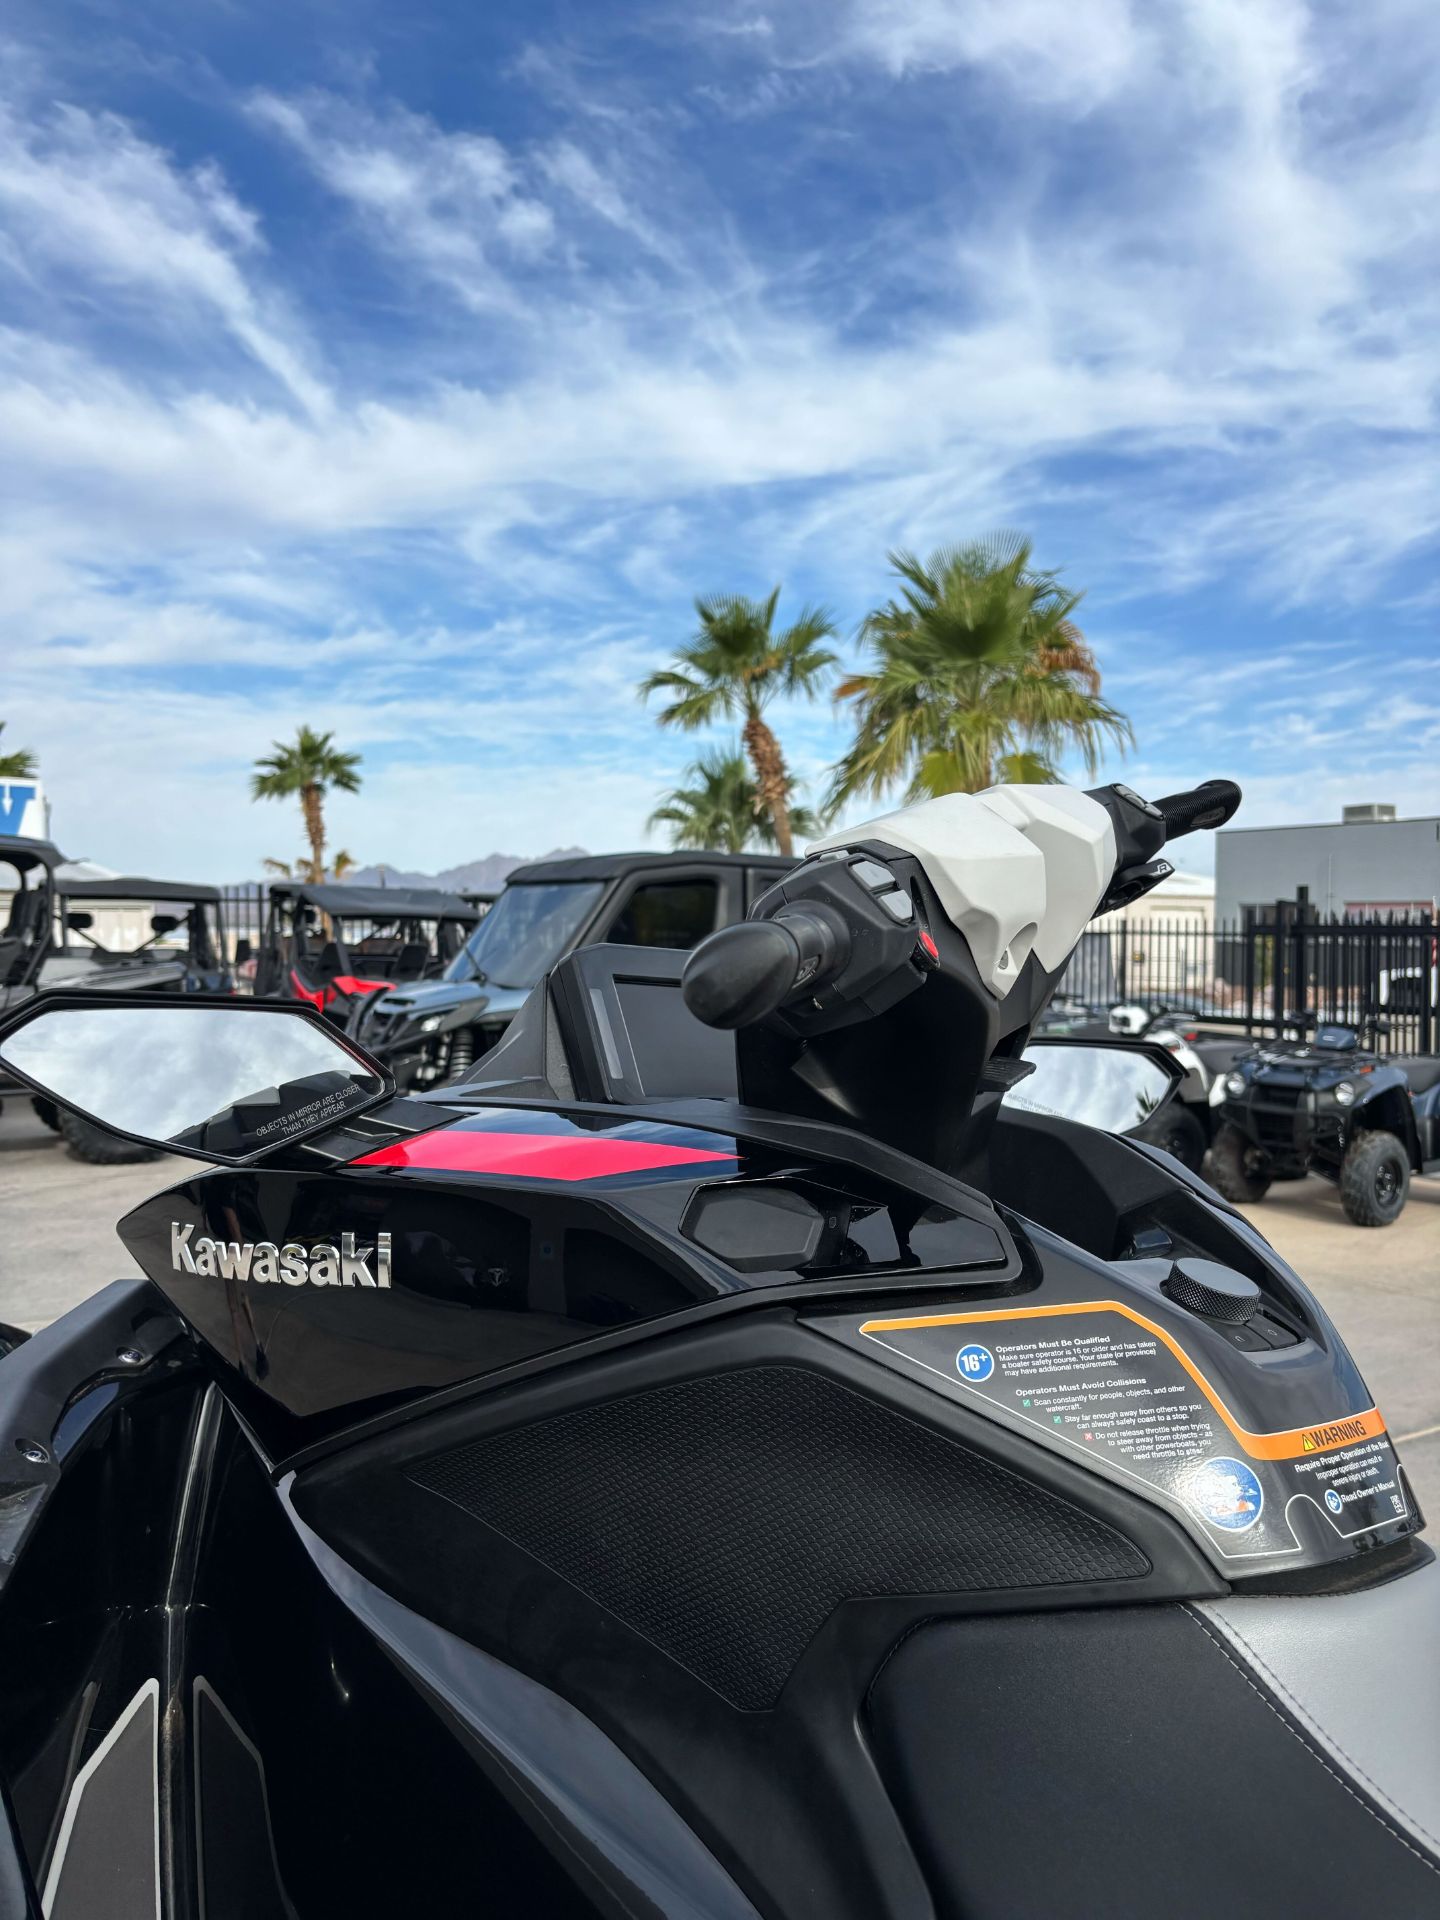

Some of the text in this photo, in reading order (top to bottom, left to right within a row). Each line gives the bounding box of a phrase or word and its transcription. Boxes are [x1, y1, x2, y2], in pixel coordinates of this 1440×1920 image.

[256, 1084, 360, 1137] OBJECTS IN MIRROR ARE CLOSER
[282, 1101, 346, 1136] THAN THEY APPEAR
[171, 1221, 392, 1289] Kawasaki
[996, 1344, 1037, 1353] Operators
[1038, 1340, 1060, 1348] Must
[1074, 1336, 1110, 1346] Qualified
[1032, 1358, 1052, 1366] safety
[1114, 1351, 1124, 1359] (or
[1126, 1348, 1156, 1358] province)
[1036, 1350, 1064, 1359] operator
[1038, 1364, 1072, 1372] additional
[1073, 1360, 1118, 1370] requirements.
[1016, 1378, 1146, 1396] Operators Must Avoid Collisions
[1052, 1394, 1088, 1404] constantly
[1100, 1391, 1125, 1400] people,
[1126, 1389, 1153, 1398] objects,
[1046, 1403, 1082, 1412] watercraft.
[1091, 1420, 1115, 1428] always
[1116, 1418, 1136, 1426] safely
[1092, 1411, 1118, 1420] enough
[1120, 1428, 1144, 1437] release
[1146, 1426, 1170, 1434] throttle
[1190, 1422, 1210, 1431] trying
[1172, 1432, 1198, 1441] objects
[1310, 1420, 1367, 1448] WARNING
[1120, 1445, 1136, 1453] with
[1156, 1440, 1198, 1450] powerboats,
[1133, 1452, 1151, 1460] need
[1152, 1450, 1176, 1458] throttle
[1294, 1462, 1321, 1472] Require
[1320, 1456, 1340, 1466] Proper
[1340, 1447, 1366, 1460] Operation
[1366, 1444, 1372, 1452] of
[1371, 1443, 1380, 1451] the
[1316, 1468, 1339, 1480] Improper
[1338, 1462, 1360, 1474] operation
[1332, 1478, 1348, 1486] severe
[1348, 1474, 1362, 1482] injury
[1340, 1480, 1396, 1502] Read Owner's Manual
